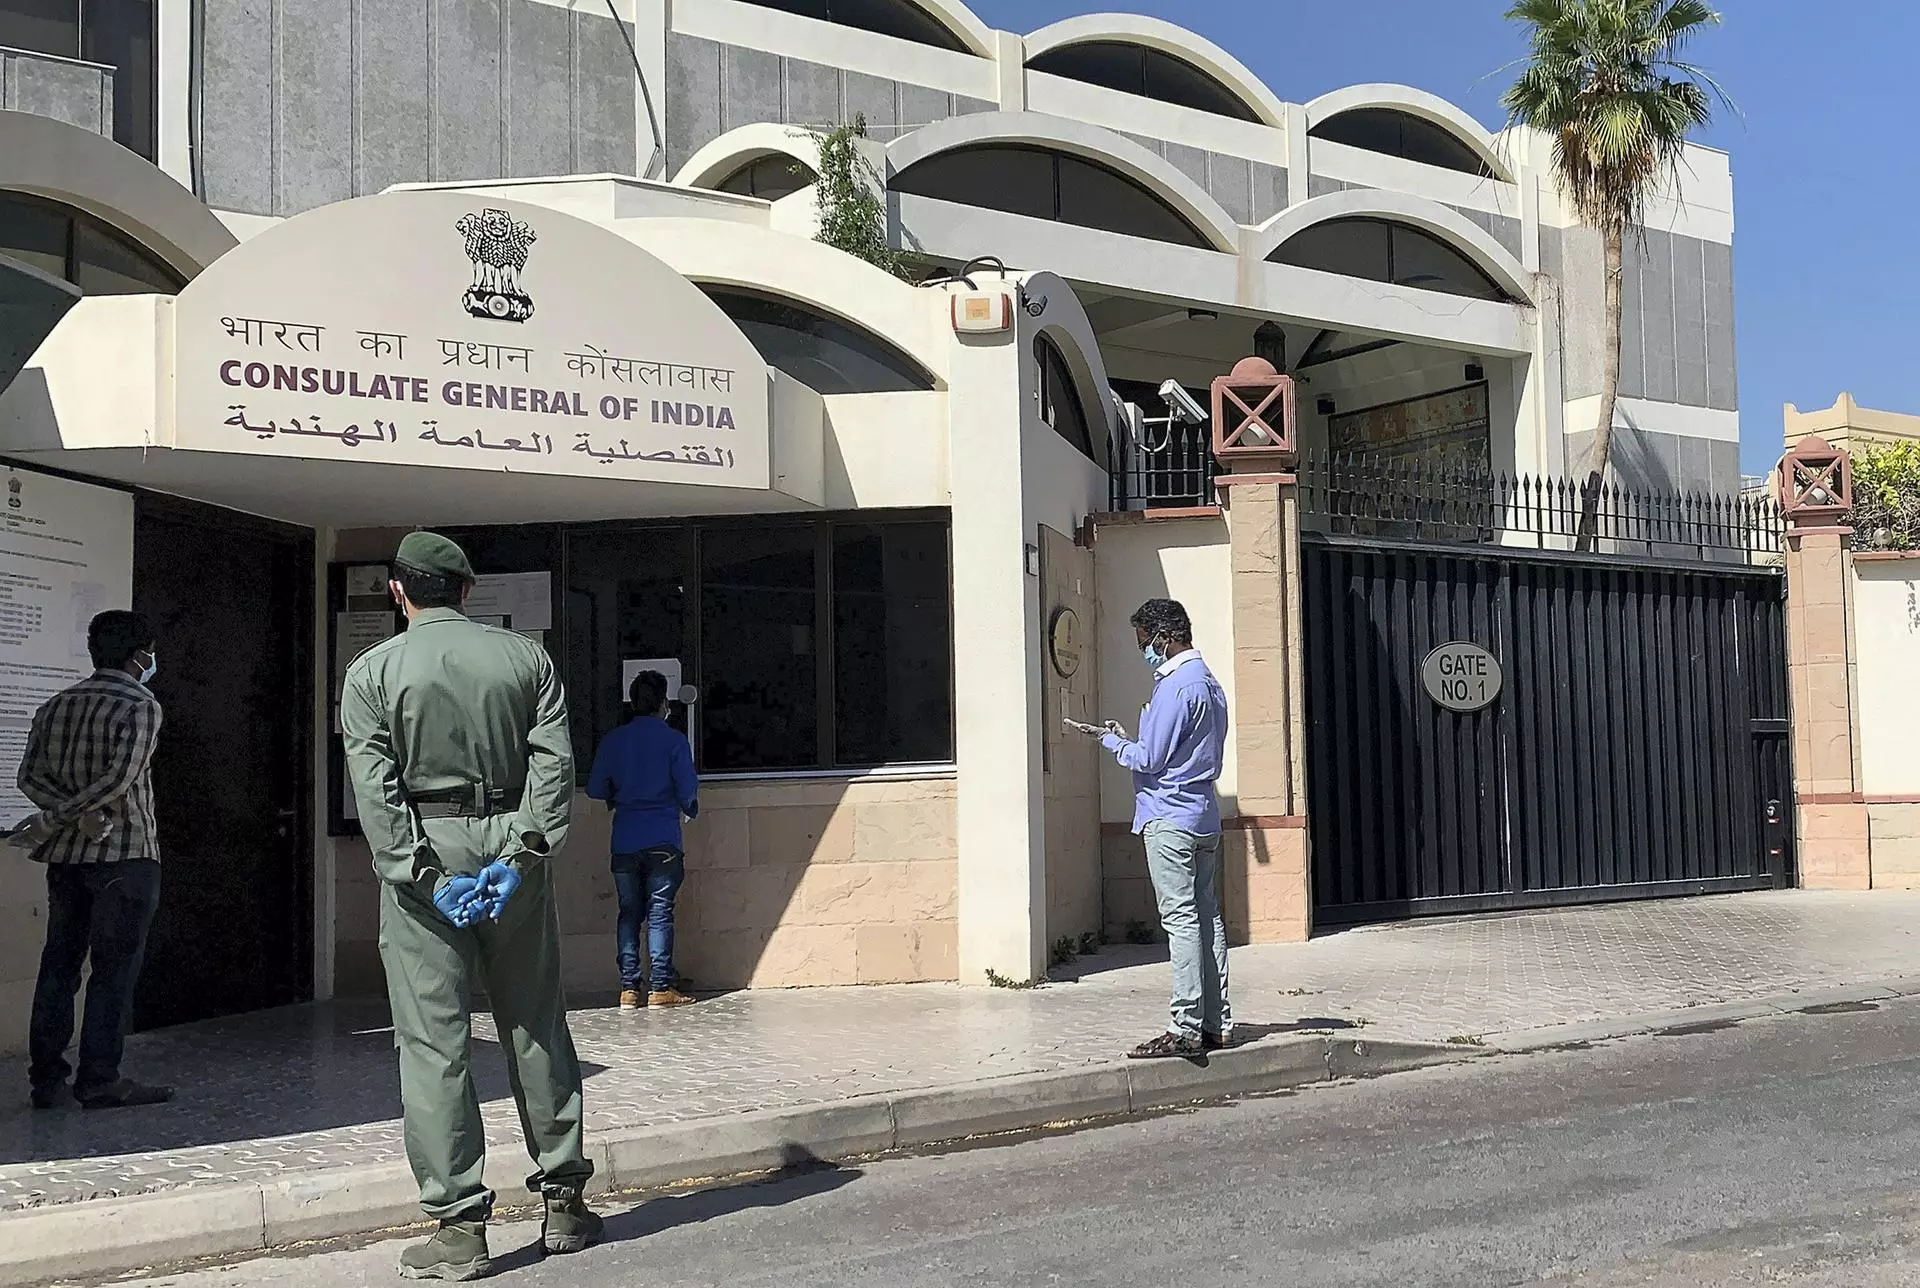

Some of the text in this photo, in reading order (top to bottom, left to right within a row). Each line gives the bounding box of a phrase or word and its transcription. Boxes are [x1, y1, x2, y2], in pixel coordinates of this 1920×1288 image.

[220, 316, 735, 392] भारत का प्रधान कोंसलावास
[219, 360, 735, 430] CONSULATE GENERAL OF INDIA
[224, 404, 735, 468] القنصلية العامة الهندية
[1440, 654, 1487, 675] GATE
[1441, 679, 1486, 701] NO. 1
